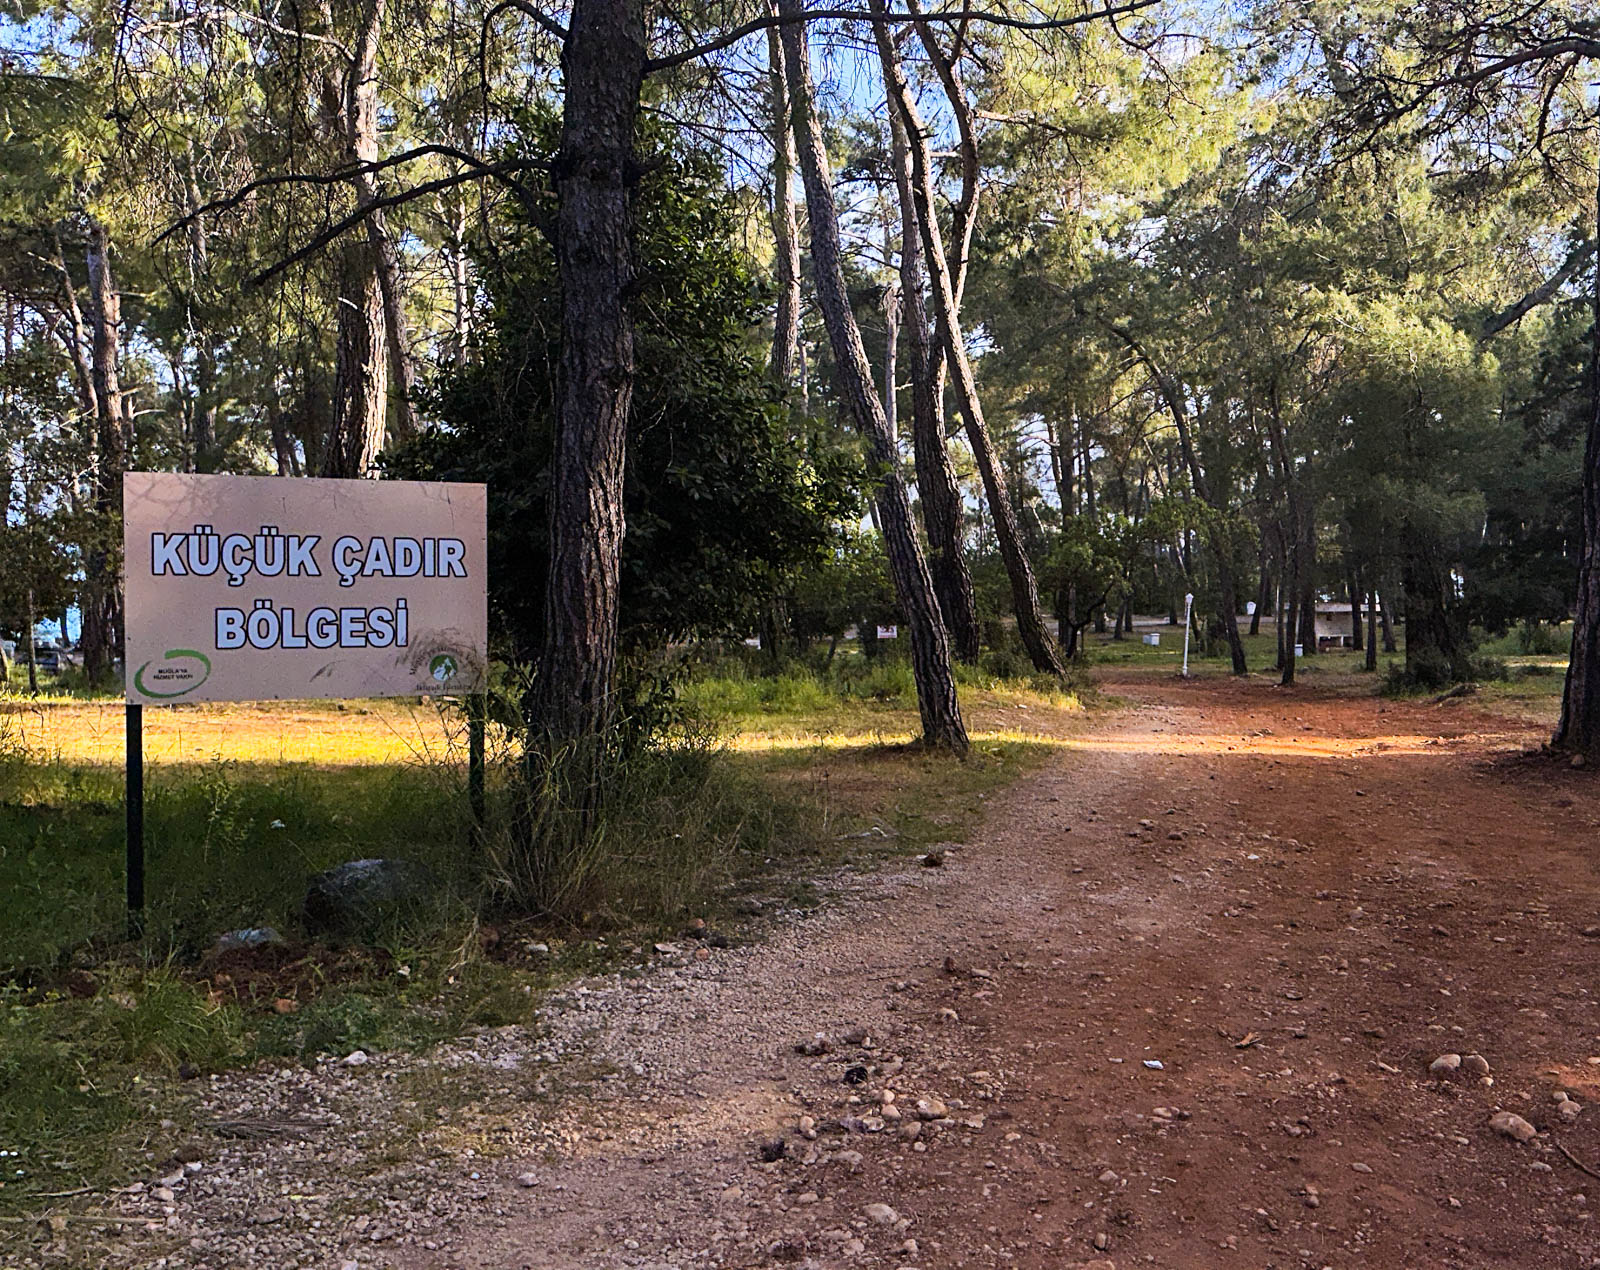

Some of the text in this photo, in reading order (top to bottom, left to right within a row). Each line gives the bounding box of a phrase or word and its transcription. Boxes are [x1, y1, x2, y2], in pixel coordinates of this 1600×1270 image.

[151, 525, 467, 587] KÜÇÜK ÇADIR
[215, 598, 408, 649] BÖLGESİ
